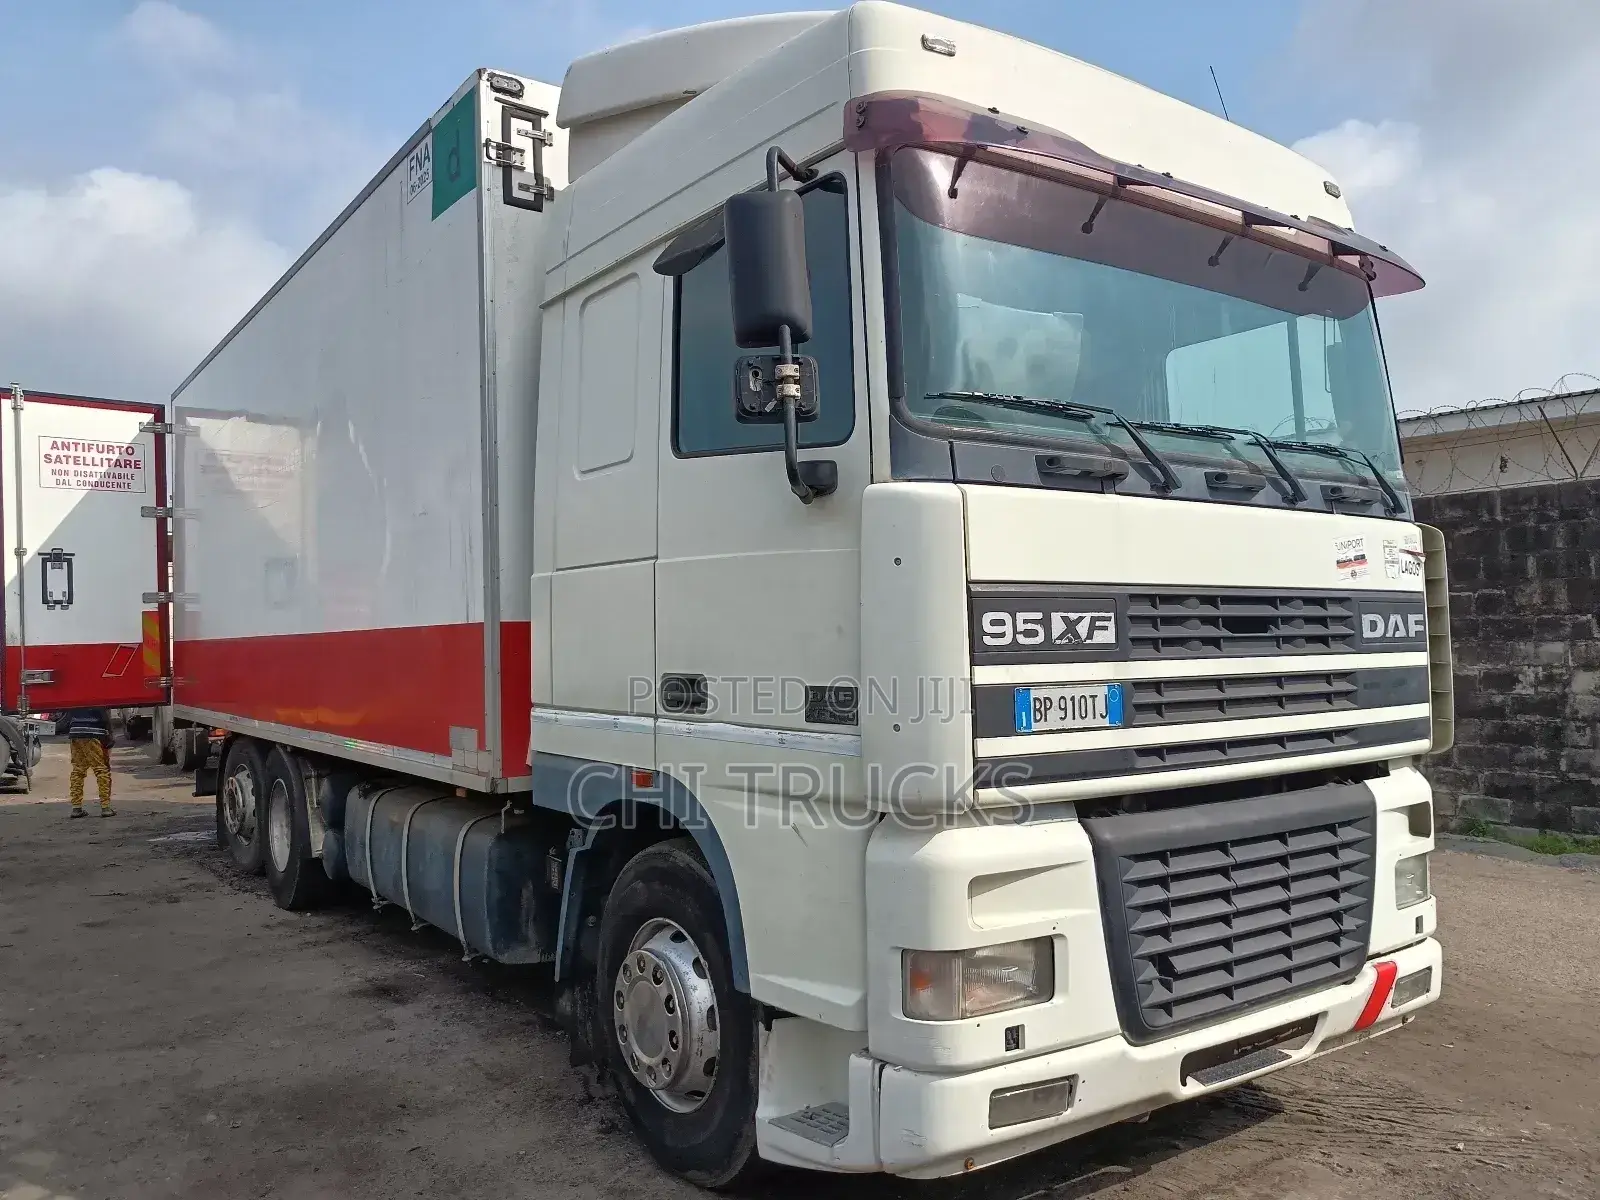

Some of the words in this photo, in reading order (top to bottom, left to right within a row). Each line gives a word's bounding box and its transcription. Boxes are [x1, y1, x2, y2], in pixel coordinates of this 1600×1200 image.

[409, 142, 431, 182] FNA
[50, 440, 135, 456] ANTIFURTO
[43, 454, 142, 470] SATELLITARE
[51, 468, 70, 477] NON
[73, 470, 135, 481] DISATTIVABILE
[55, 478, 72, 487] DAL
[76, 478, 132, 490] CONDUCENTE
[981, 611, 1045, 646] 95
[1051, 612, 1116, 644] XF
[1361, 613, 1425, 638] DAF
[1032, 696, 1054, 724] BP
[1058, 693, 1109, 722] 910TJ
